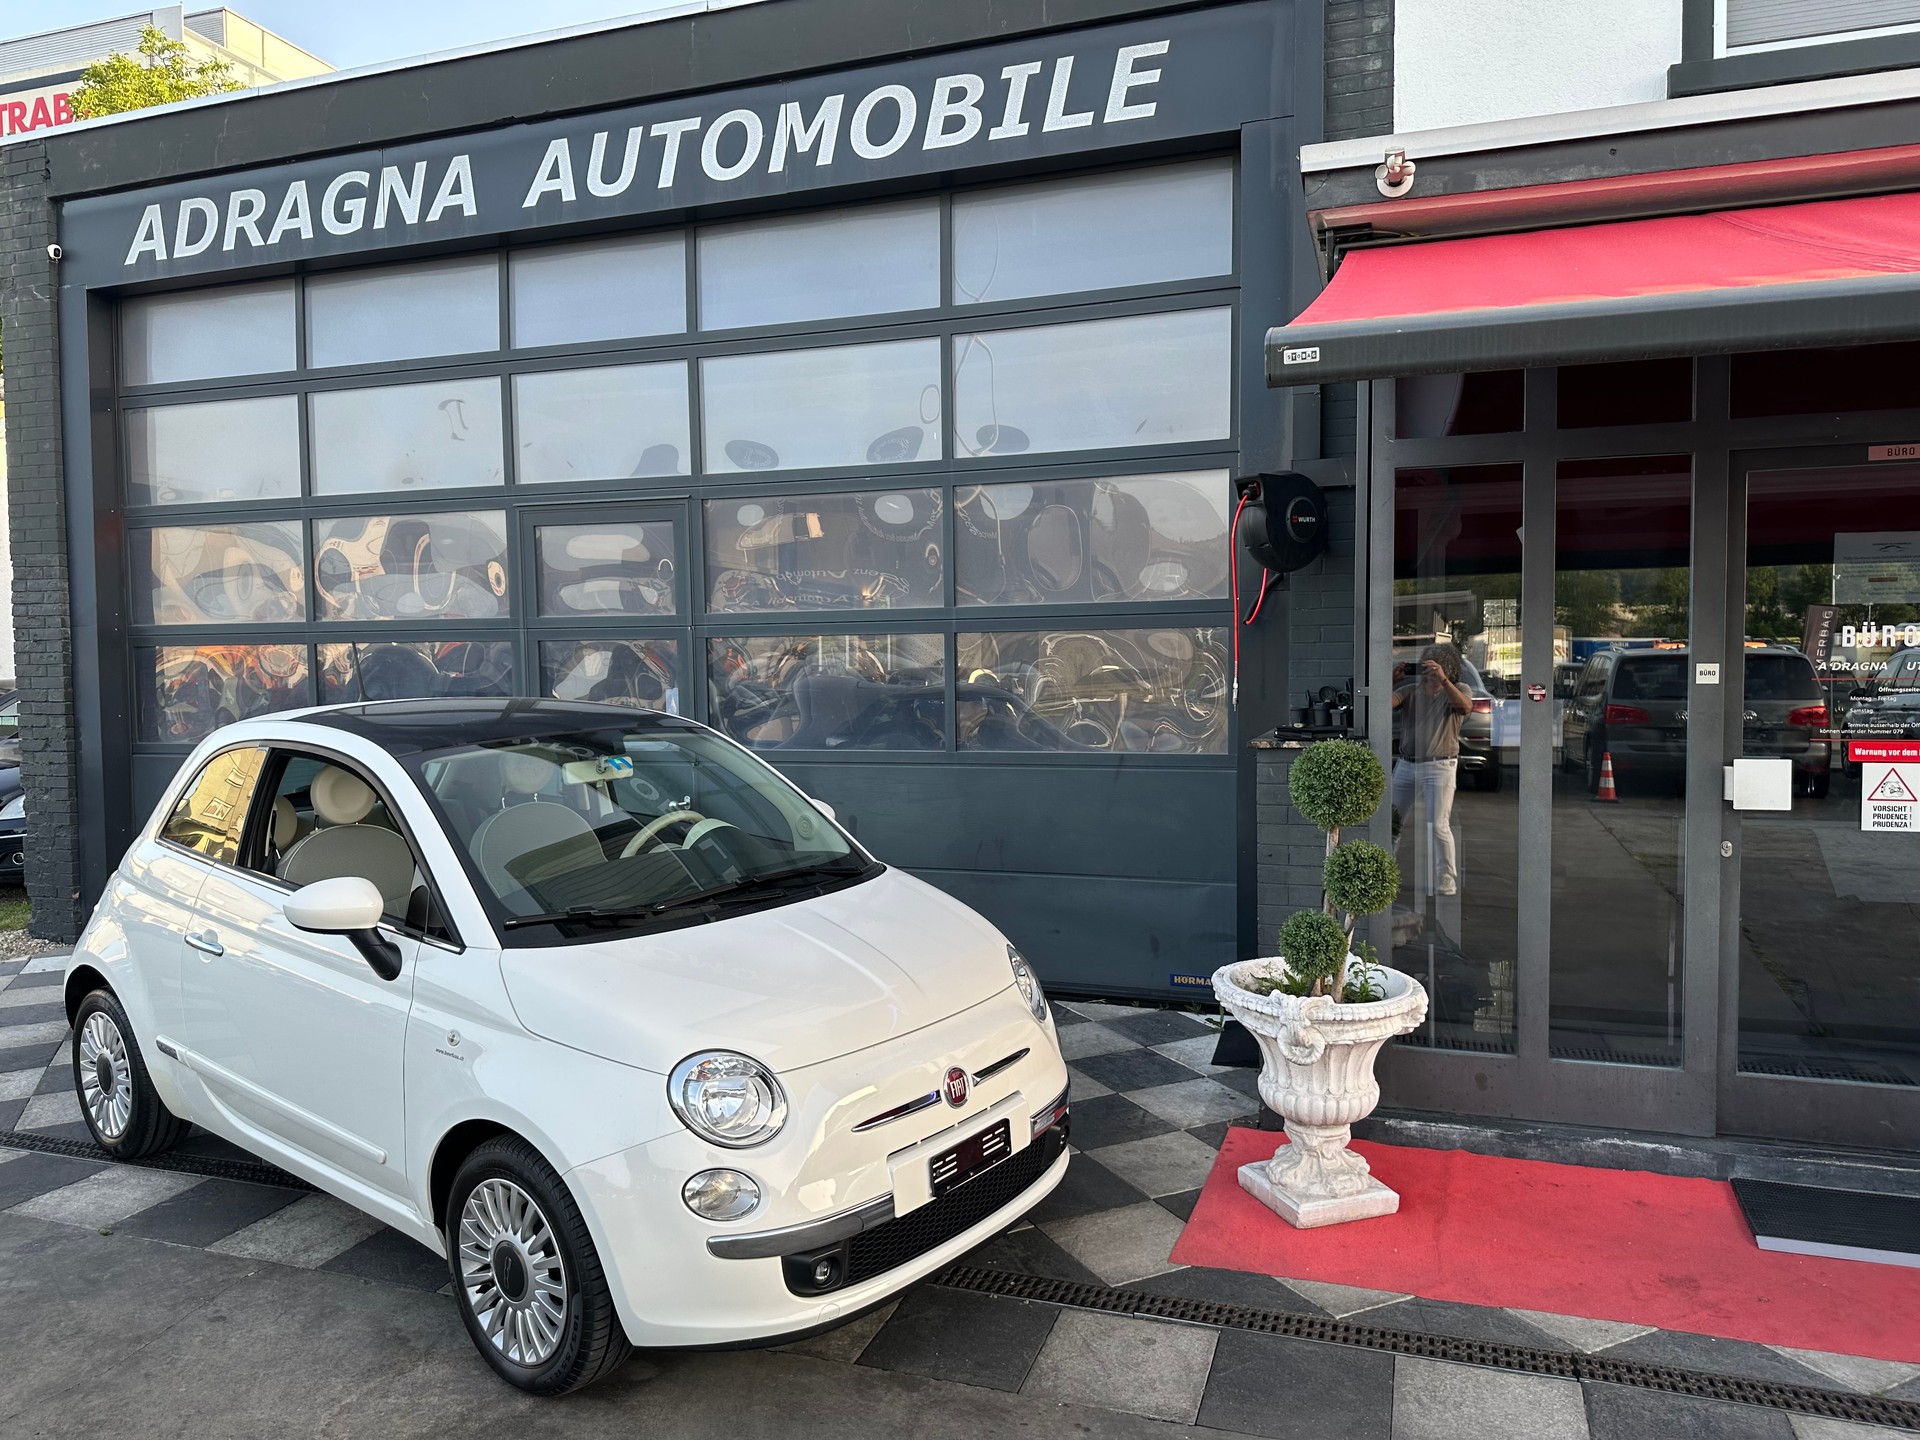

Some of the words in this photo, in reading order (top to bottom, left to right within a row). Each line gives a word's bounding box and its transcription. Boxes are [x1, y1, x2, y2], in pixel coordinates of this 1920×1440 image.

[124, 154, 478, 266] ADRAGNA
[521, 39, 1171, 208] AUTOMOBILE
[1887, 446, 1915, 457] BÜRO
[1842, 621, 1920, 648] BÜRO
[1699, 668, 1716, 676] BÜRO
[1854, 747, 1887, 757] Warnung
[1902, 747, 1918, 756] dem
[1872, 820, 1908, 828] PRUDENZA
[950, 1077, 965, 1099] FIAT
